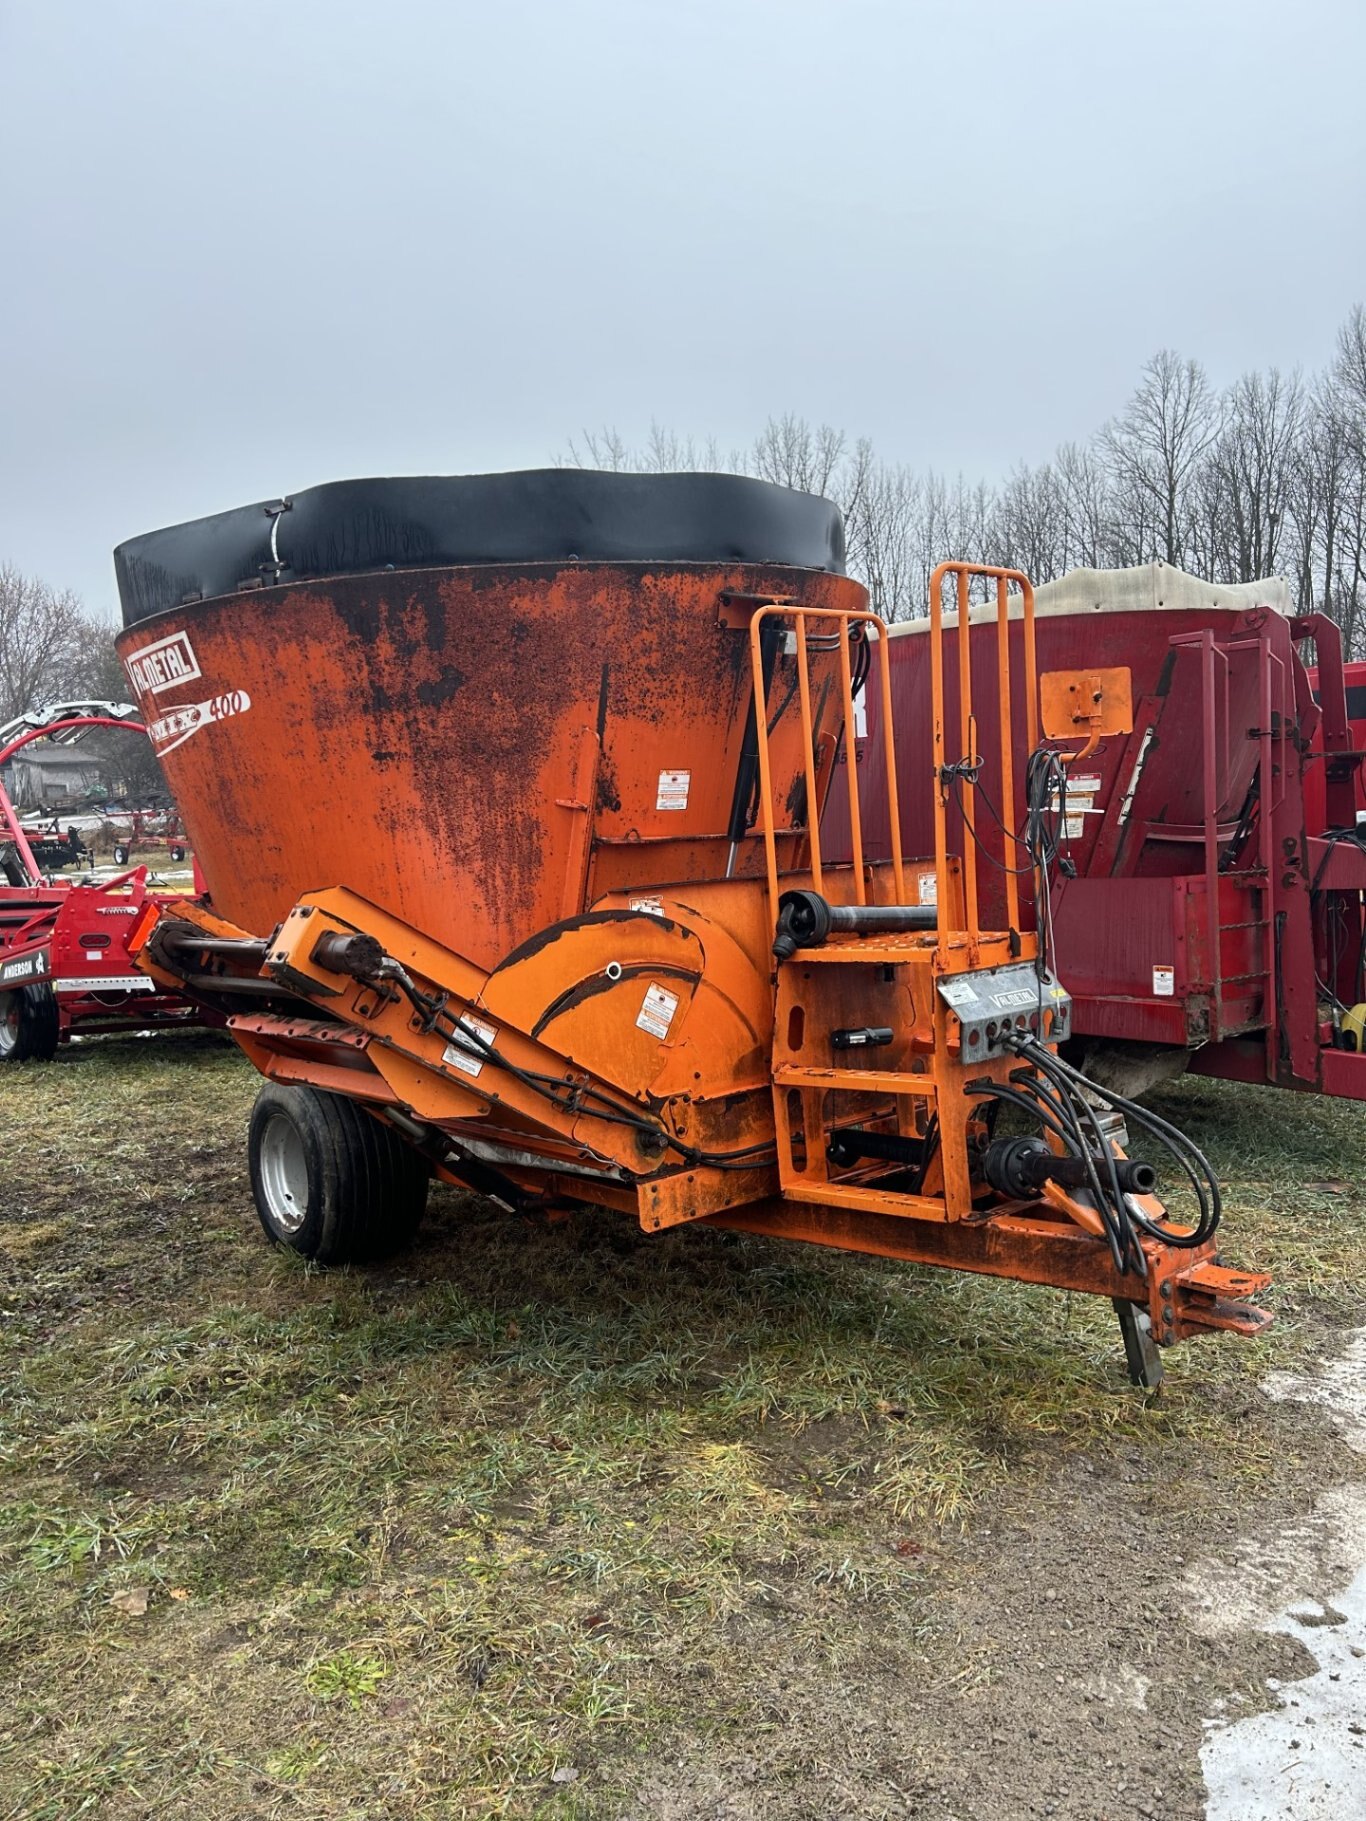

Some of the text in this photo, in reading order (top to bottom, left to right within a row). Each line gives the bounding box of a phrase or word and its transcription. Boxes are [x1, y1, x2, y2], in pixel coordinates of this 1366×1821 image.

[210, 691, 242, 721] 400
[4, 960, 33, 980] ANDERSON
[988, 988, 1037, 1008] VALMETAL
